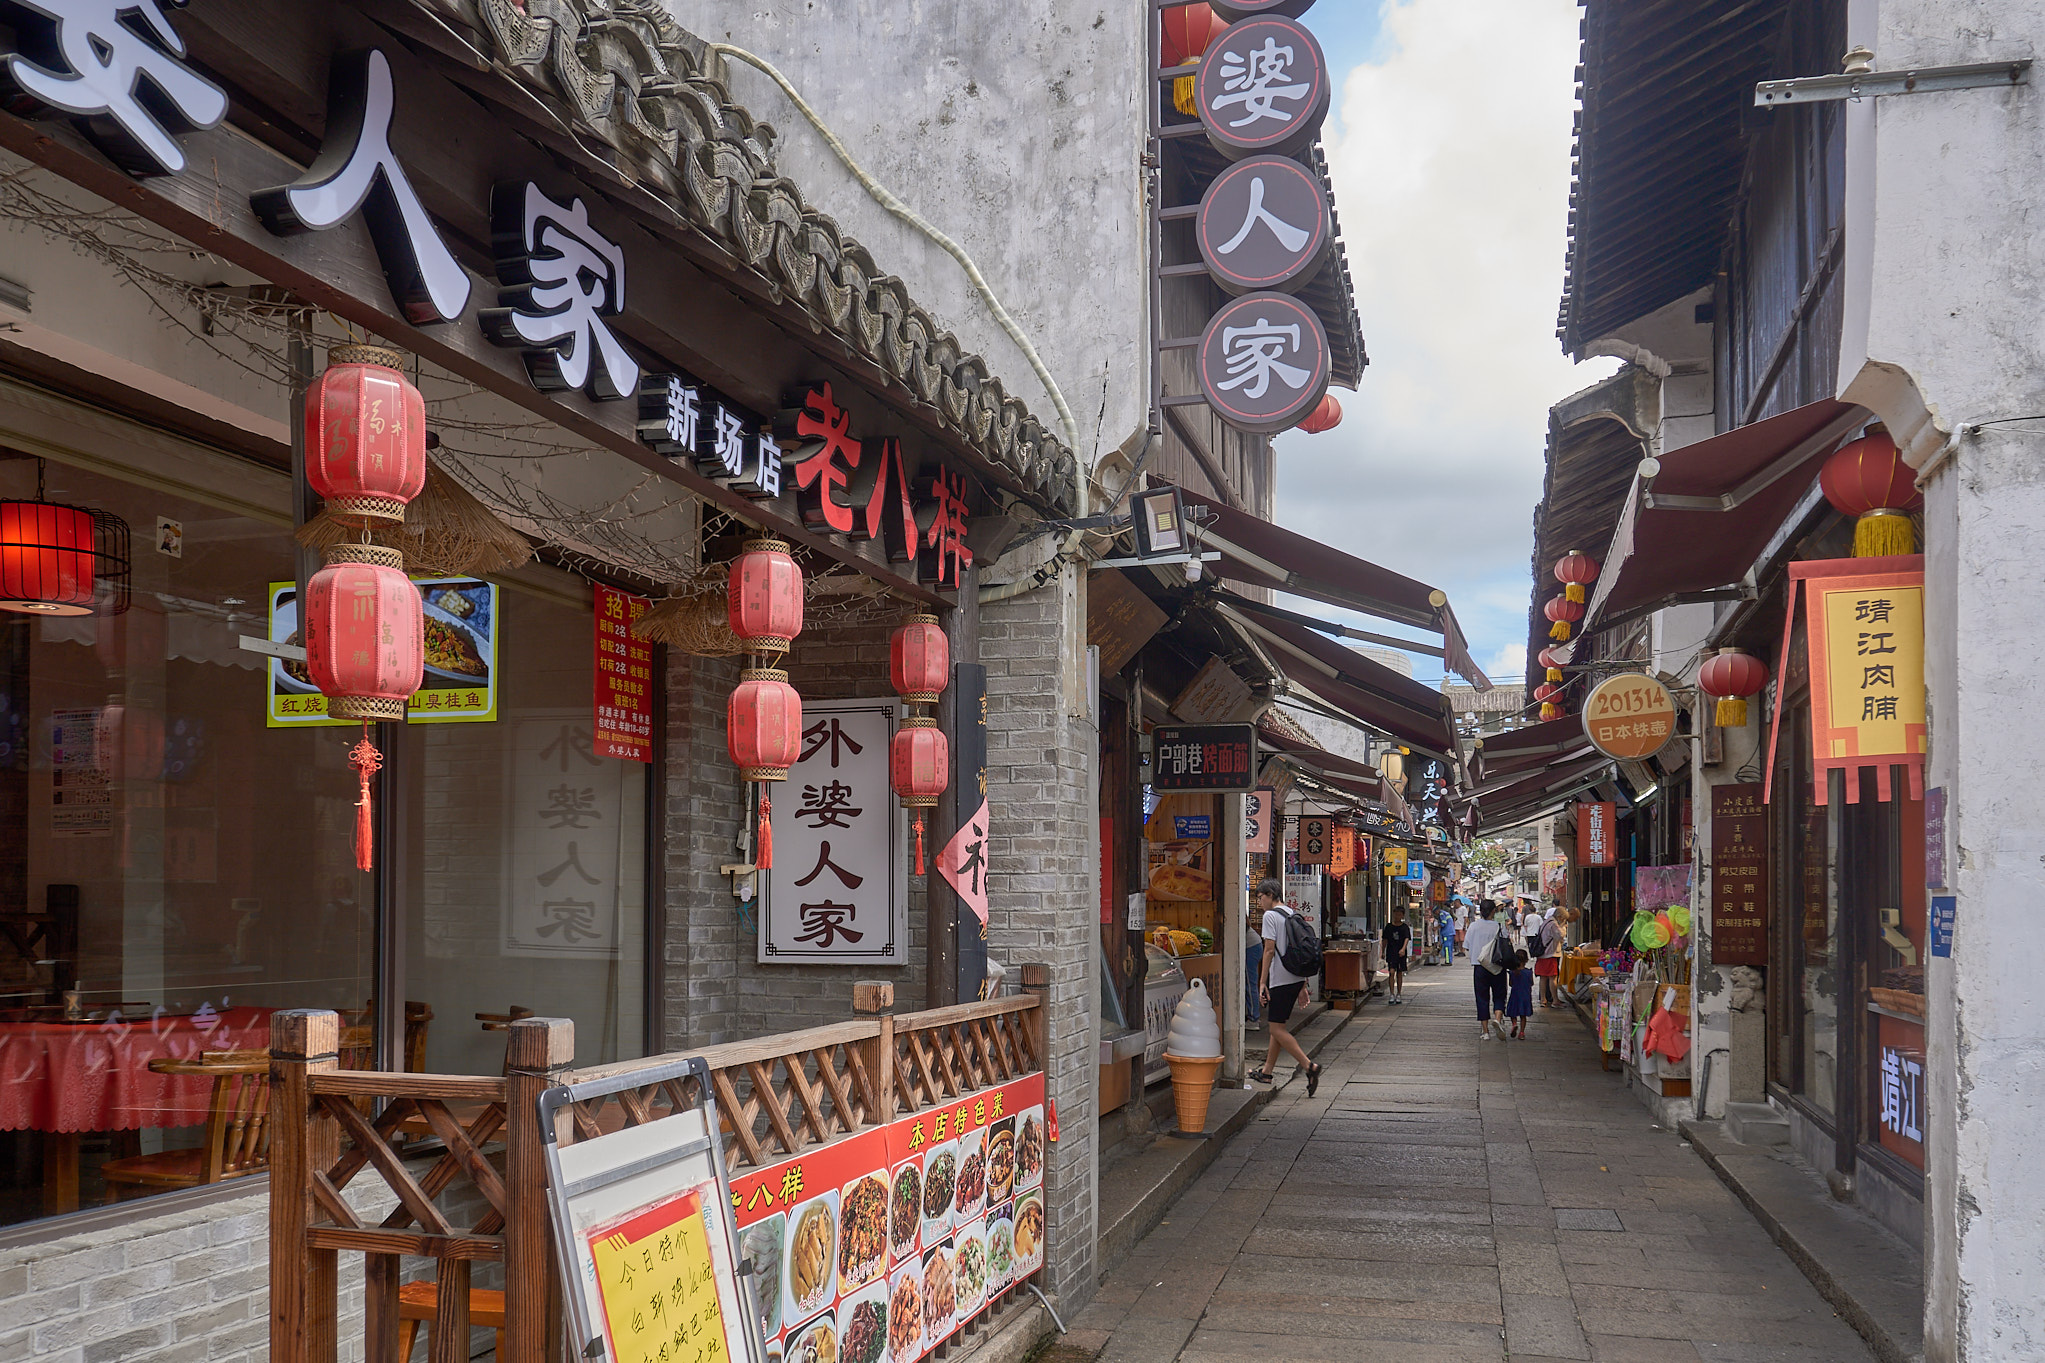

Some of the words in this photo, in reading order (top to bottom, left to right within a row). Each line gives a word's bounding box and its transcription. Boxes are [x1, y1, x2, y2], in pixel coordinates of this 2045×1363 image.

[1211, 36, 1311, 399] 婆人家
[667, 377, 782, 498] 新场店
[795, 381, 973, 590] 老八样
[605, 594, 645, 620] 招聘
[1855, 598, 1899, 721] 靖江肉脯
[281, 696, 328, 713] 红烧
[1597, 686, 1666, 715] 201314
[1157, 742, 1248, 775] 户部巷烤面筋
[794, 717, 864, 948] 外婆人家
[1309, 822, 1321, 853] 零食
[1719, 866, 1758, 876] 男女皮包
[908, 1091, 1004, 1151] 本店特色菜
[1881, 1046, 1927, 1142] 靖江
[619, 1229, 689, 1291] 今日特价
